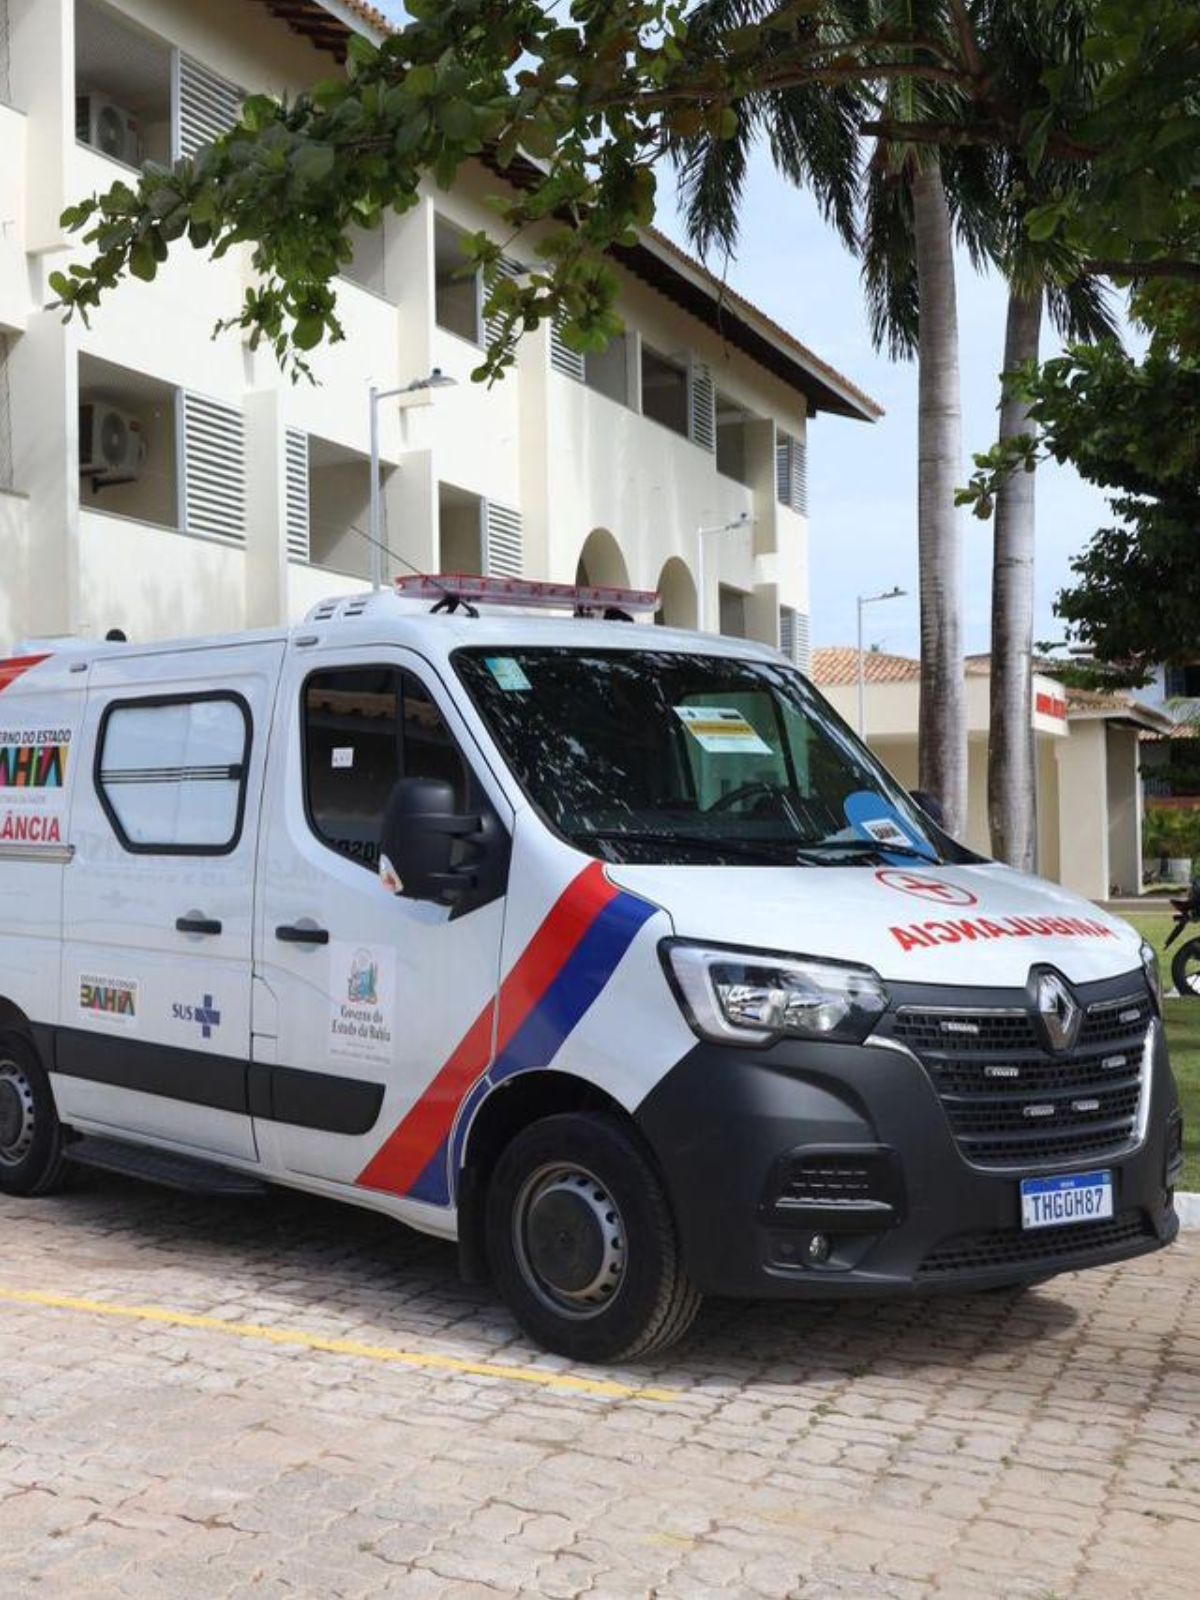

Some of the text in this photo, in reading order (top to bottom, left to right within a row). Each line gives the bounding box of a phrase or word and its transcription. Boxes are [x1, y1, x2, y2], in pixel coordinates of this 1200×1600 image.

[22, 730, 36, 744] DO
[37, 728, 72, 743] ESTADO
[80, 983, 137, 1017] BAHIA
[171, 1002, 194, 1021] SUS
